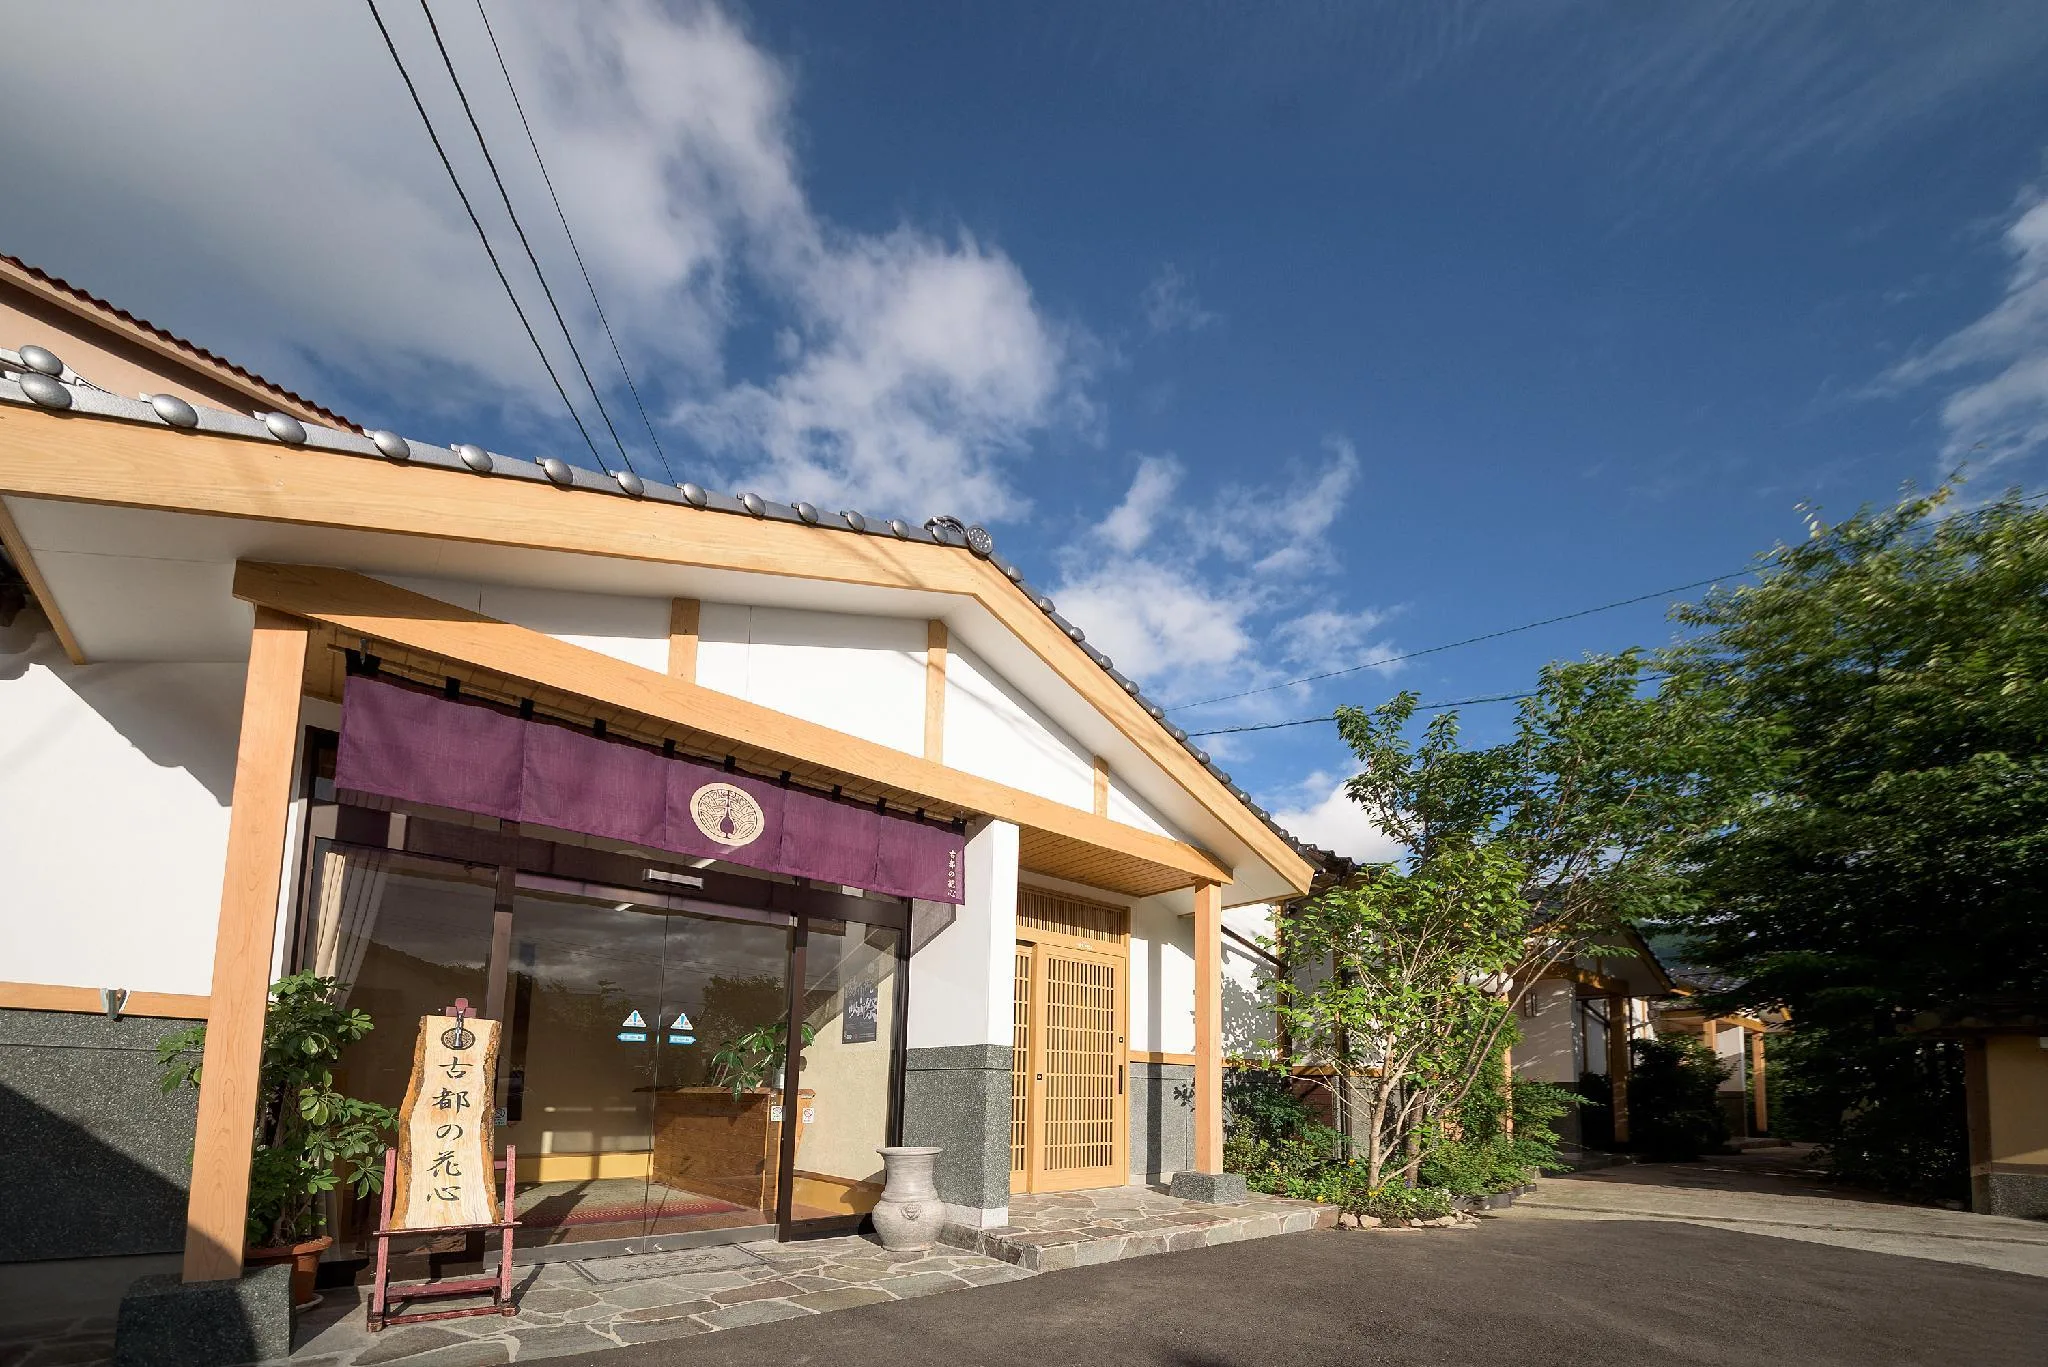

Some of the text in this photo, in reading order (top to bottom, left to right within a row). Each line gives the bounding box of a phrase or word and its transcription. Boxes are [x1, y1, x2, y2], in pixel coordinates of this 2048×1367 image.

[426, 1056, 474, 1203] 古都の花心
